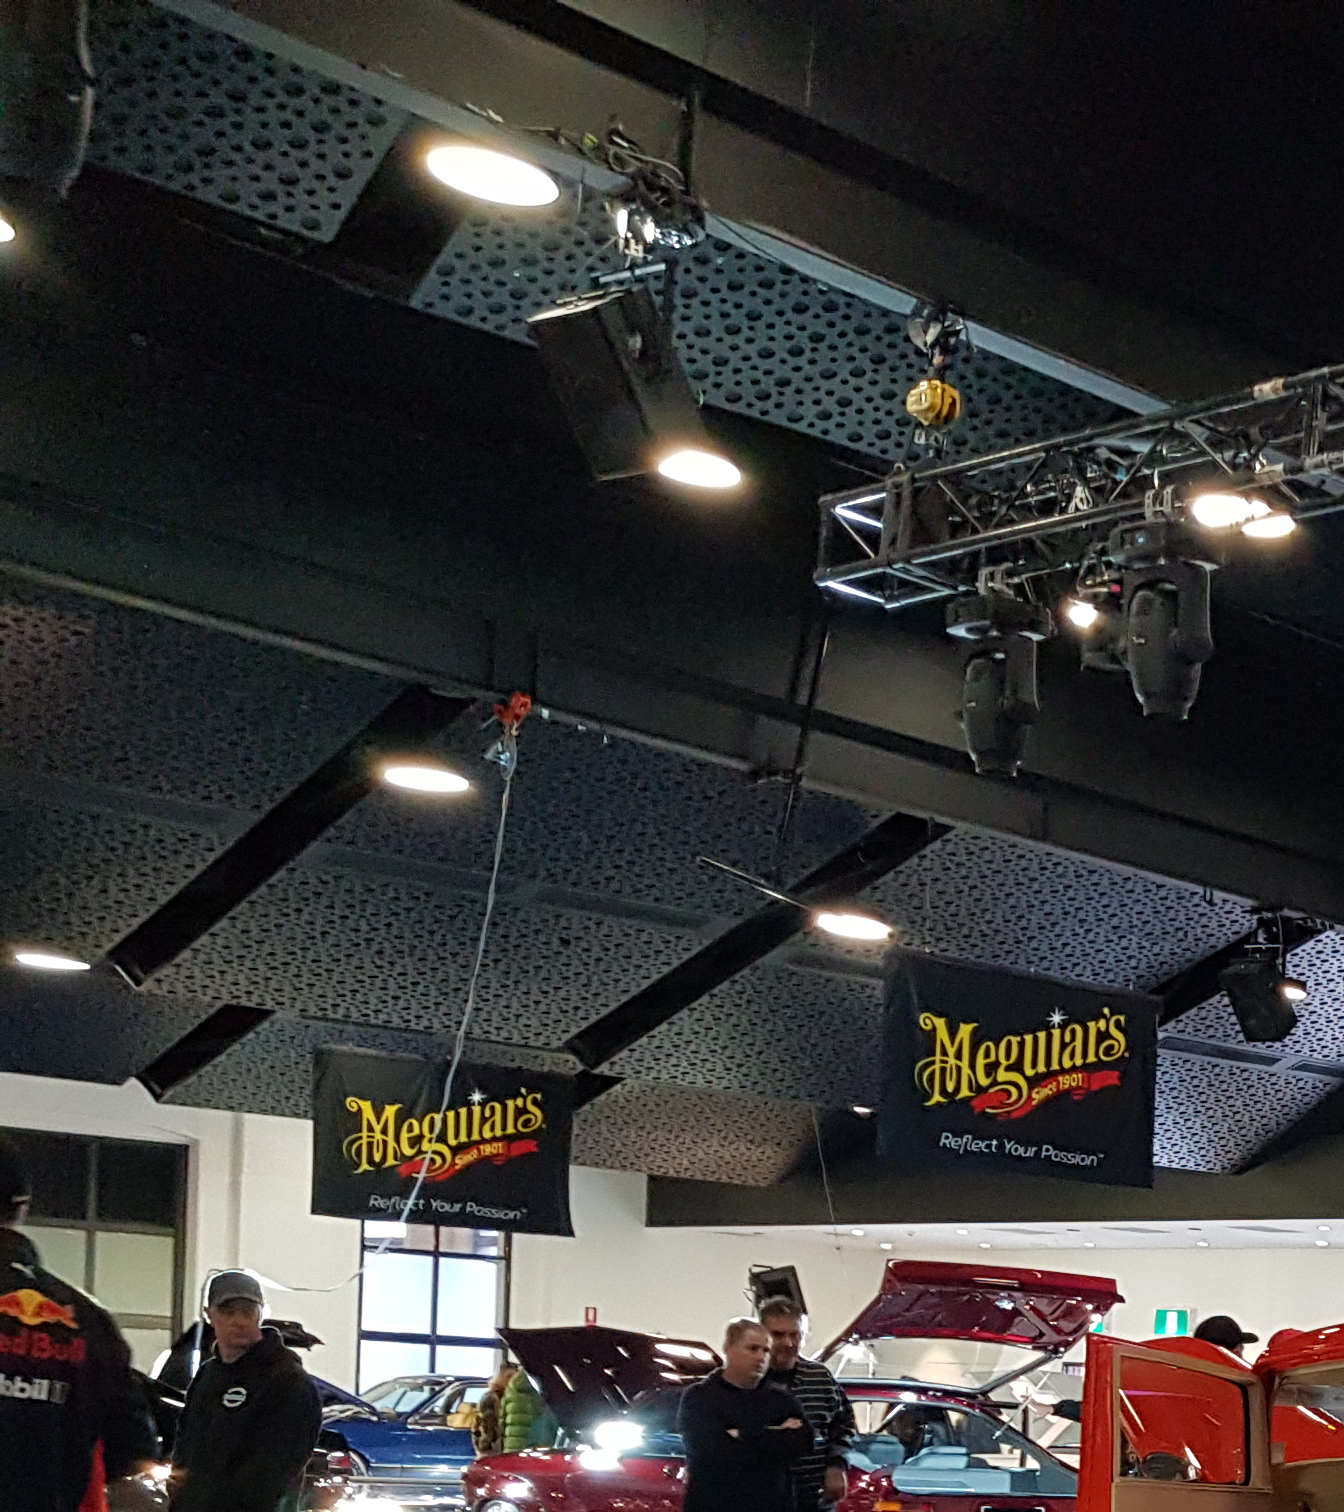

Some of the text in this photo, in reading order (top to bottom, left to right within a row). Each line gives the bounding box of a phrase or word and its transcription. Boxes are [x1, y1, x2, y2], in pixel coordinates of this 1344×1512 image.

[914, 1006, 1127, 1113] Meguiar's
[1057, 1073, 1083, 1090] 1901
[343, 1086, 546, 1178] Meguiar's
[939, 1133, 998, 1155] Reflect
[1002, 1139, 1037, 1158] Your
[429, 1198, 462, 1213] Your
[0, 1372, 50, 1401] obil
